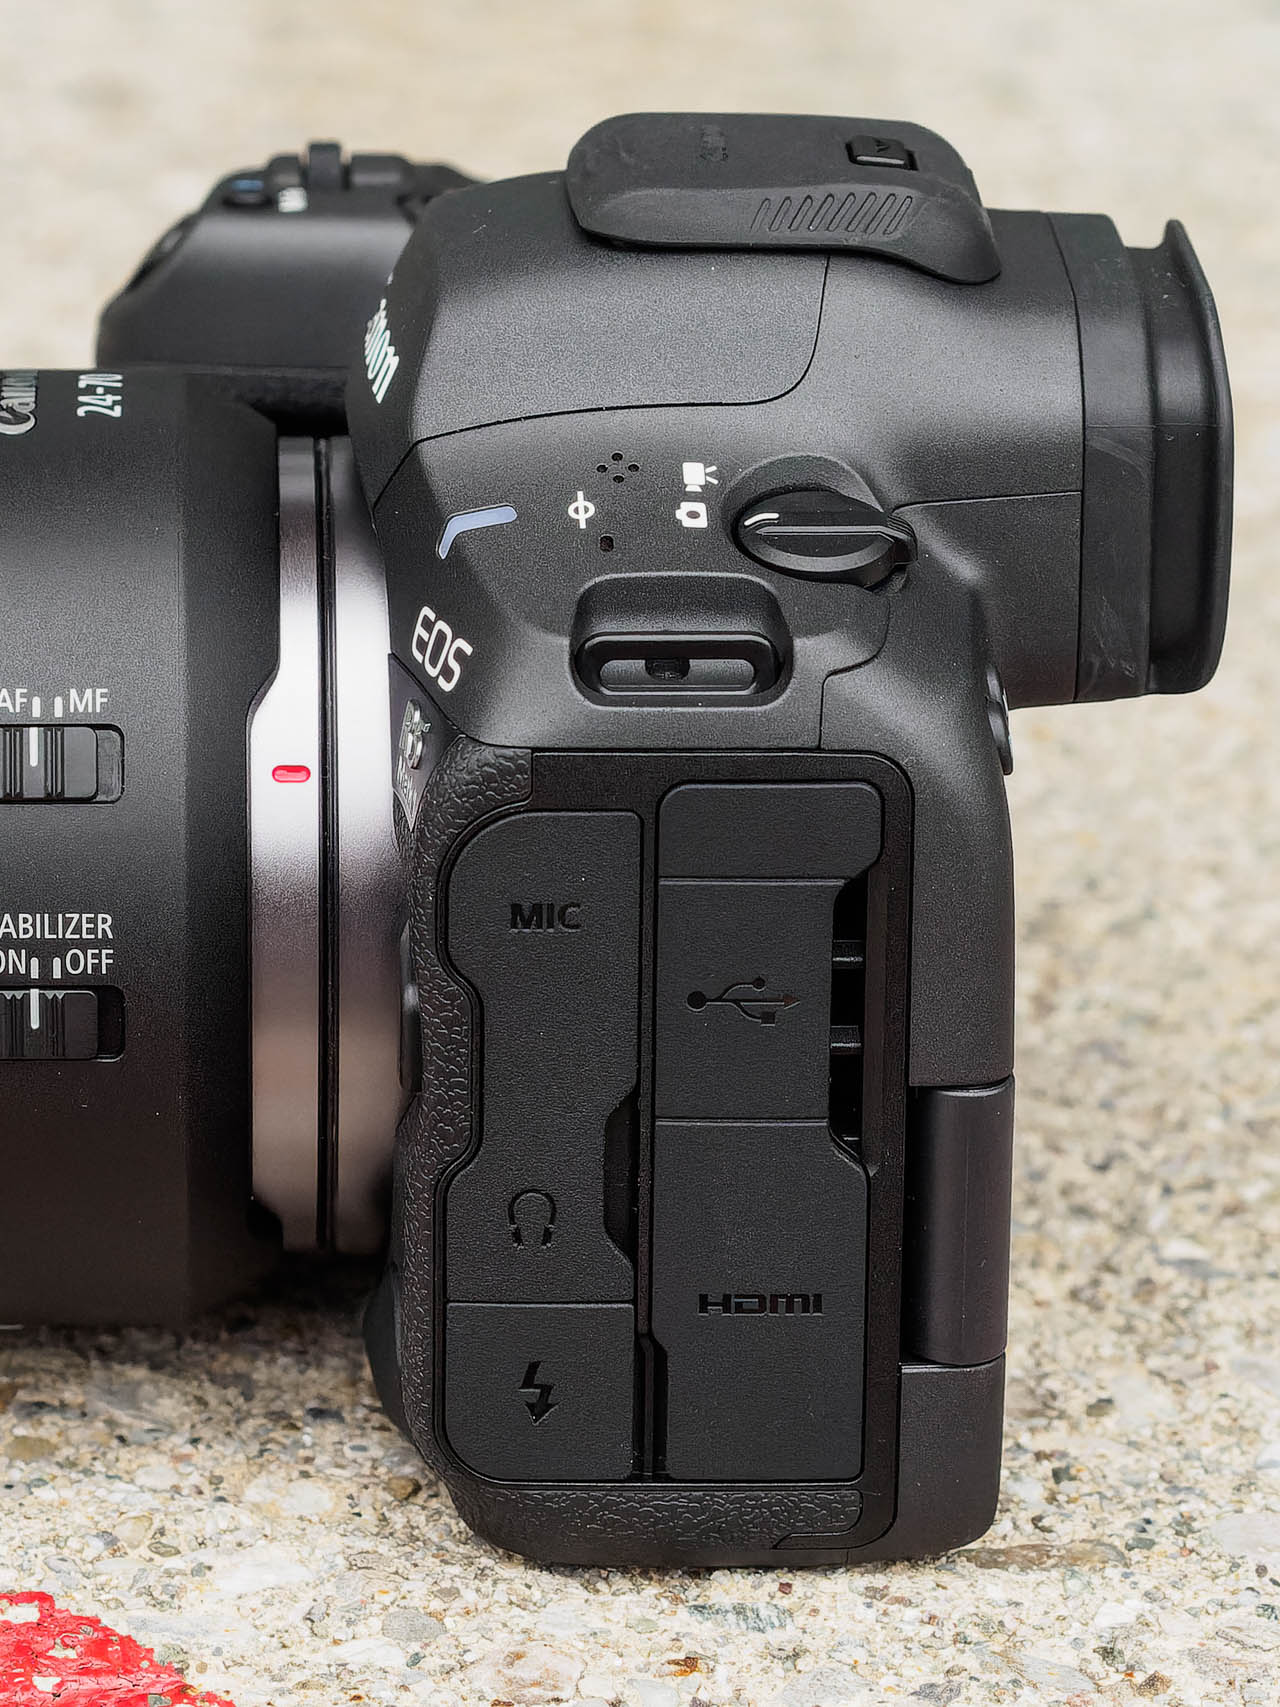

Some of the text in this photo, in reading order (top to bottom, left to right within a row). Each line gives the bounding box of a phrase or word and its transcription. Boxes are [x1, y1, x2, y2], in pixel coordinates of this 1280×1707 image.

[411, 605, 474, 692] EOS
[70, 688, 108, 713] MF
[509, 903, 582, 931] MIC
[65, 949, 114, 975] OFF
